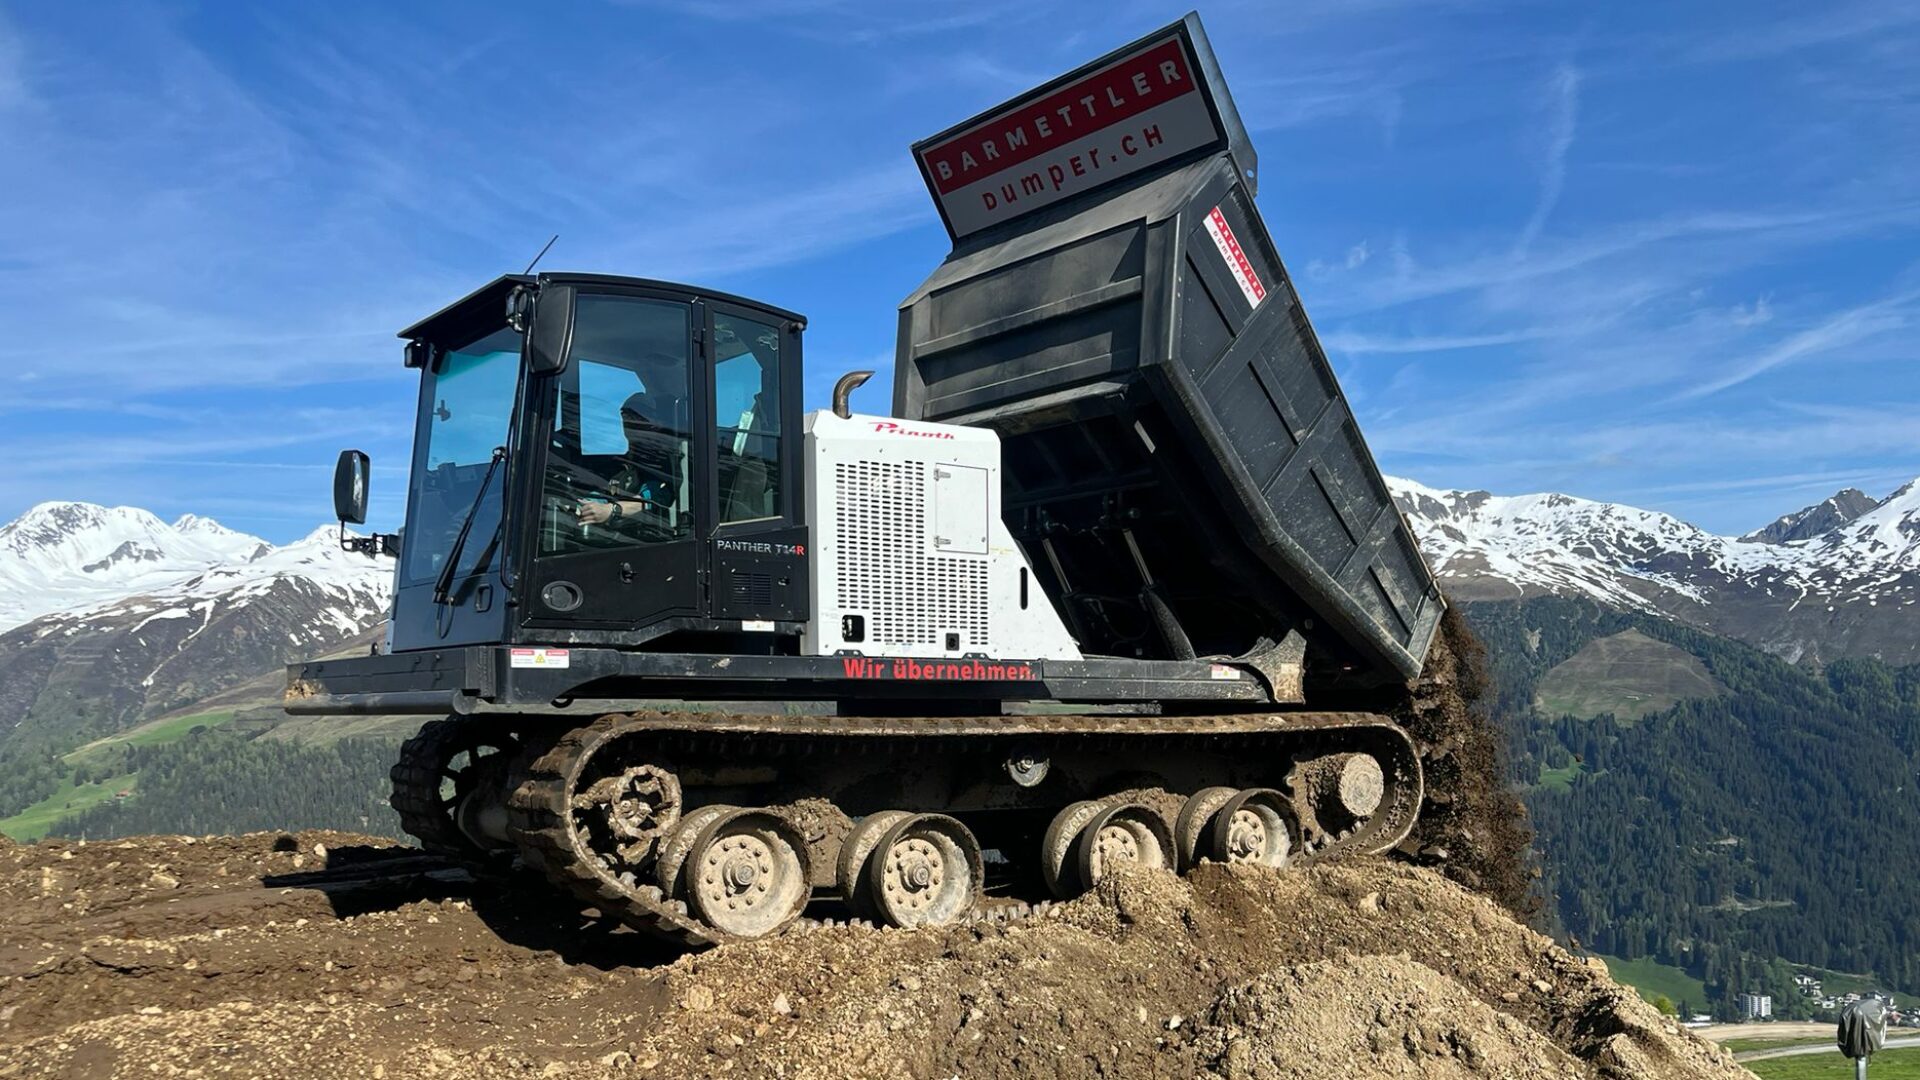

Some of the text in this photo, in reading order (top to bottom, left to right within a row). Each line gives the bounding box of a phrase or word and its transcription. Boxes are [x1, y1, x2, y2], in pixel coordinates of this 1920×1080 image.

[936, 59, 1182, 180] BARMETTLER
[1211, 211, 1265, 296] BARMETTLER
[717, 540, 805, 555] PANTHER T14R
[843, 658, 885, 679] Wir
